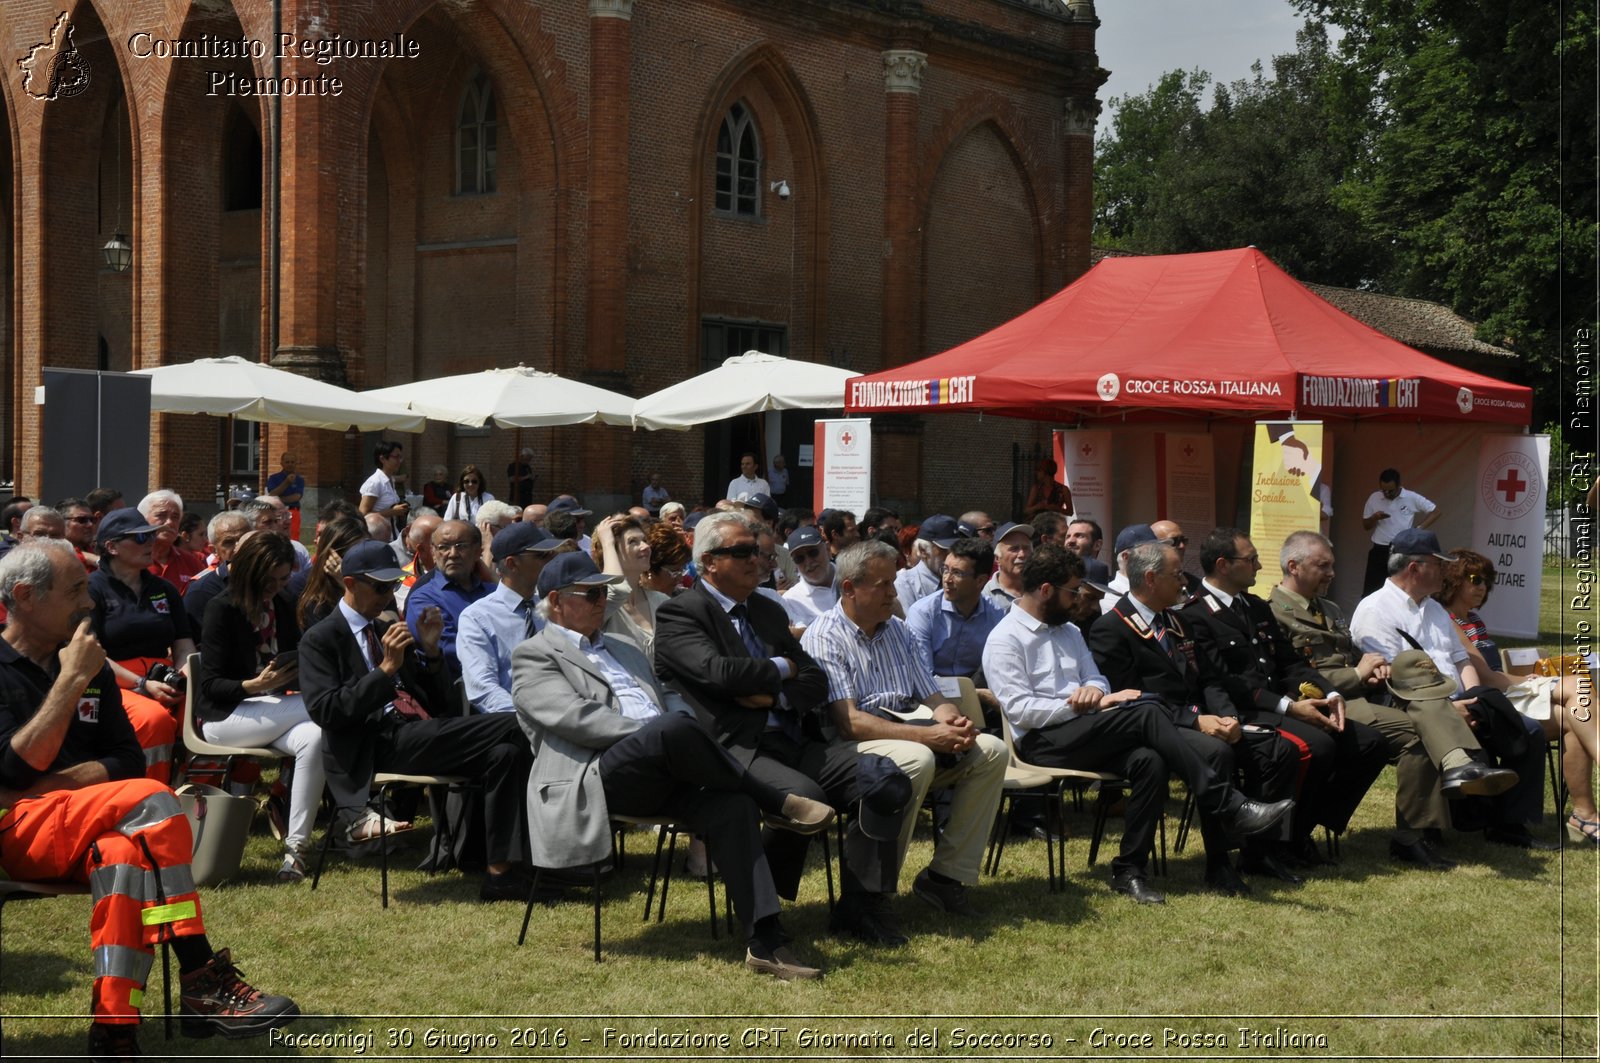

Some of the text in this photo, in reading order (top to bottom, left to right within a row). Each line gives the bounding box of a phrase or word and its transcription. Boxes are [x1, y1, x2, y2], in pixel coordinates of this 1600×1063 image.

[851, 376, 976, 407] FONDAZIONE CRT
[1125, 380, 1282, 396] CROCE ROSSA ITALIANA
[1302, 376, 1420, 408] FONDAZIONE CRT
[1474, 398, 1526, 409] CROCE ROSSA ITALIANA
[1255, 472, 1301, 487] Inclusione
[1254, 489, 1295, 504] Sociale...
[1487, 533, 1526, 548] AIUTACI
[1499, 553, 1513, 567] AD
